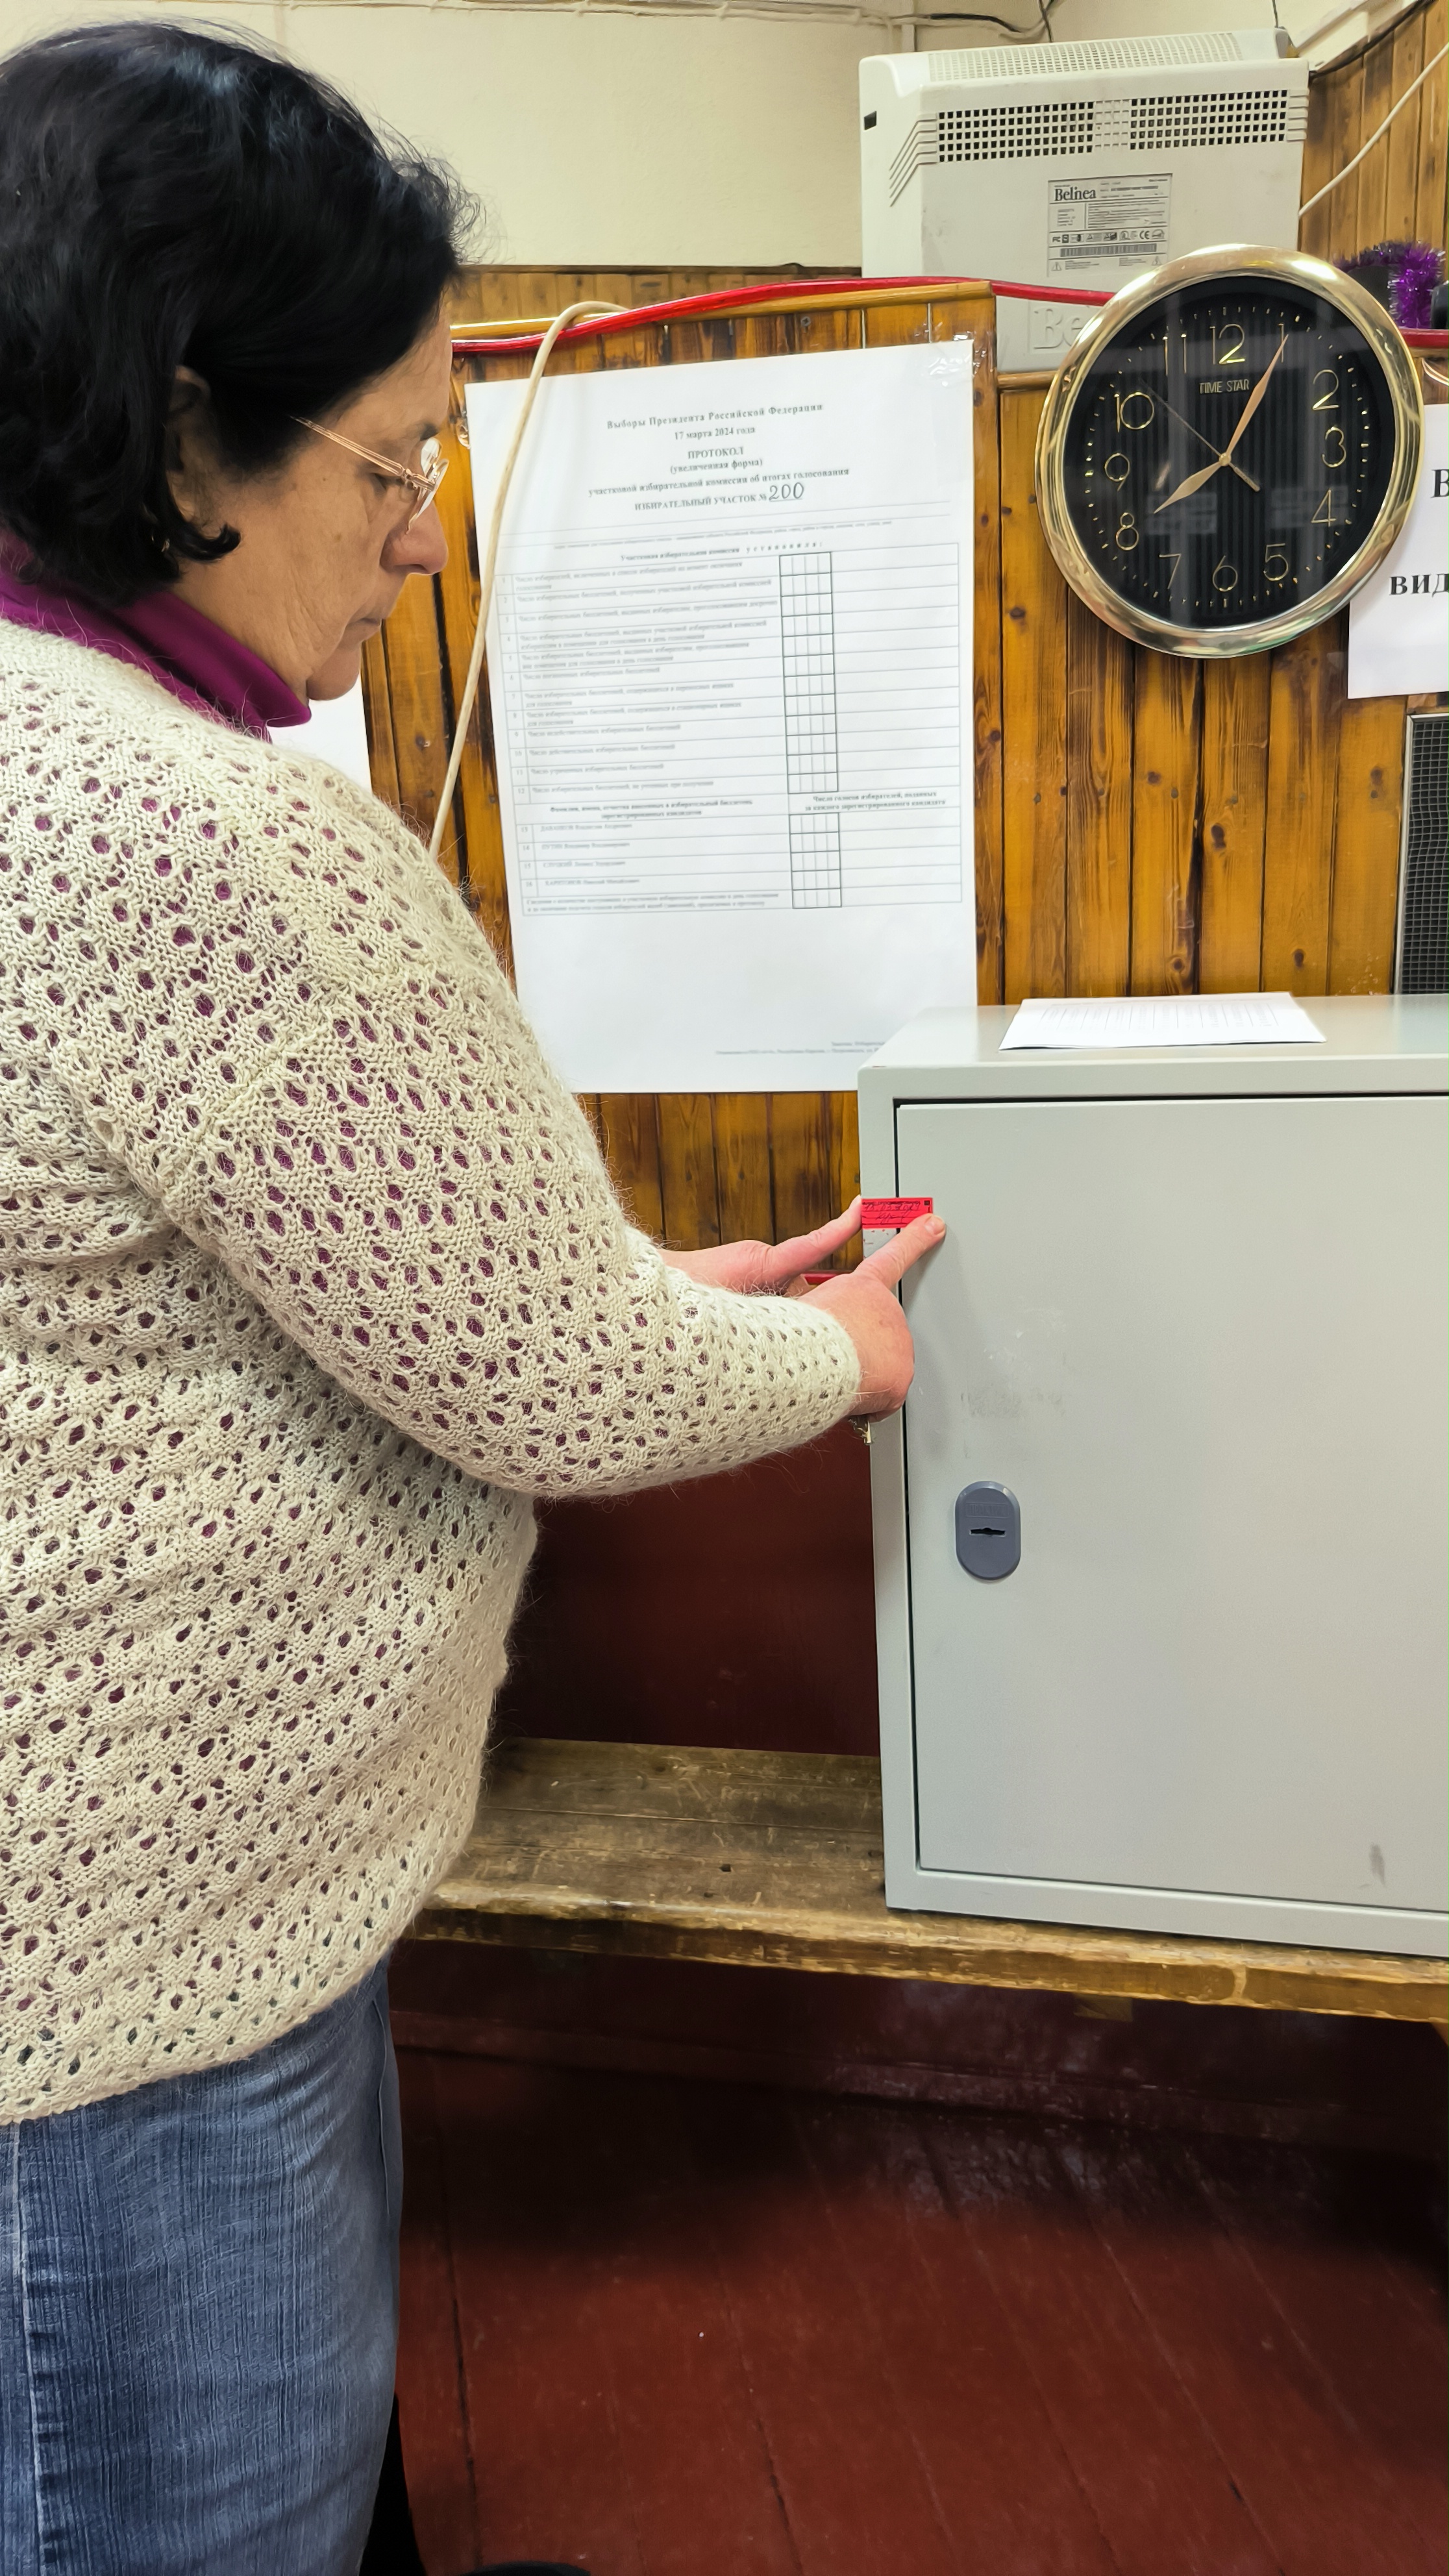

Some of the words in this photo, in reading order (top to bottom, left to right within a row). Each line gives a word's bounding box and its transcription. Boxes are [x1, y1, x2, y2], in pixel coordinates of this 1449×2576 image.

[1054, 186, 1096, 201] Belinea
[1210, 323, 1245, 365] 12
[1199, 380, 1223, 394] TIME
[1226, 378, 1250, 392] STAR
[1312, 369, 1339, 410] 2
[607, 419, 646, 429] Выборы
[649, 414, 705, 427] Президента
[708, 408, 764, 420] Российской
[768, 404, 823, 415] Федерации
[1114, 391, 1154, 432] 10
[675, 431, 684, 440] 17
[686, 430, 713, 440] марта
[715, 427, 734, 436] 2024
[1321, 426, 1346, 467] 3
[687, 446, 744, 460] ПРОТОКОЛ
[731, 458, 763, 470] форма)
[1104, 452, 1130, 491] 9
[750, 474, 760, 482] об
[793, 468, 849, 479] голосования
[769, 482, 804, 501] 200
[634, 496, 712, 511] ИЗБИРАТЕЛЬНЫЙ
[714, 494, 756, 505] УЧАСТОК
[1311, 489, 1337, 528] 4
[1115, 512, 1139, 551] 8
[1159, 552, 1182, 589] 7
[1212, 554, 1238, 592] 6
[1263, 543, 1289, 581] 5
